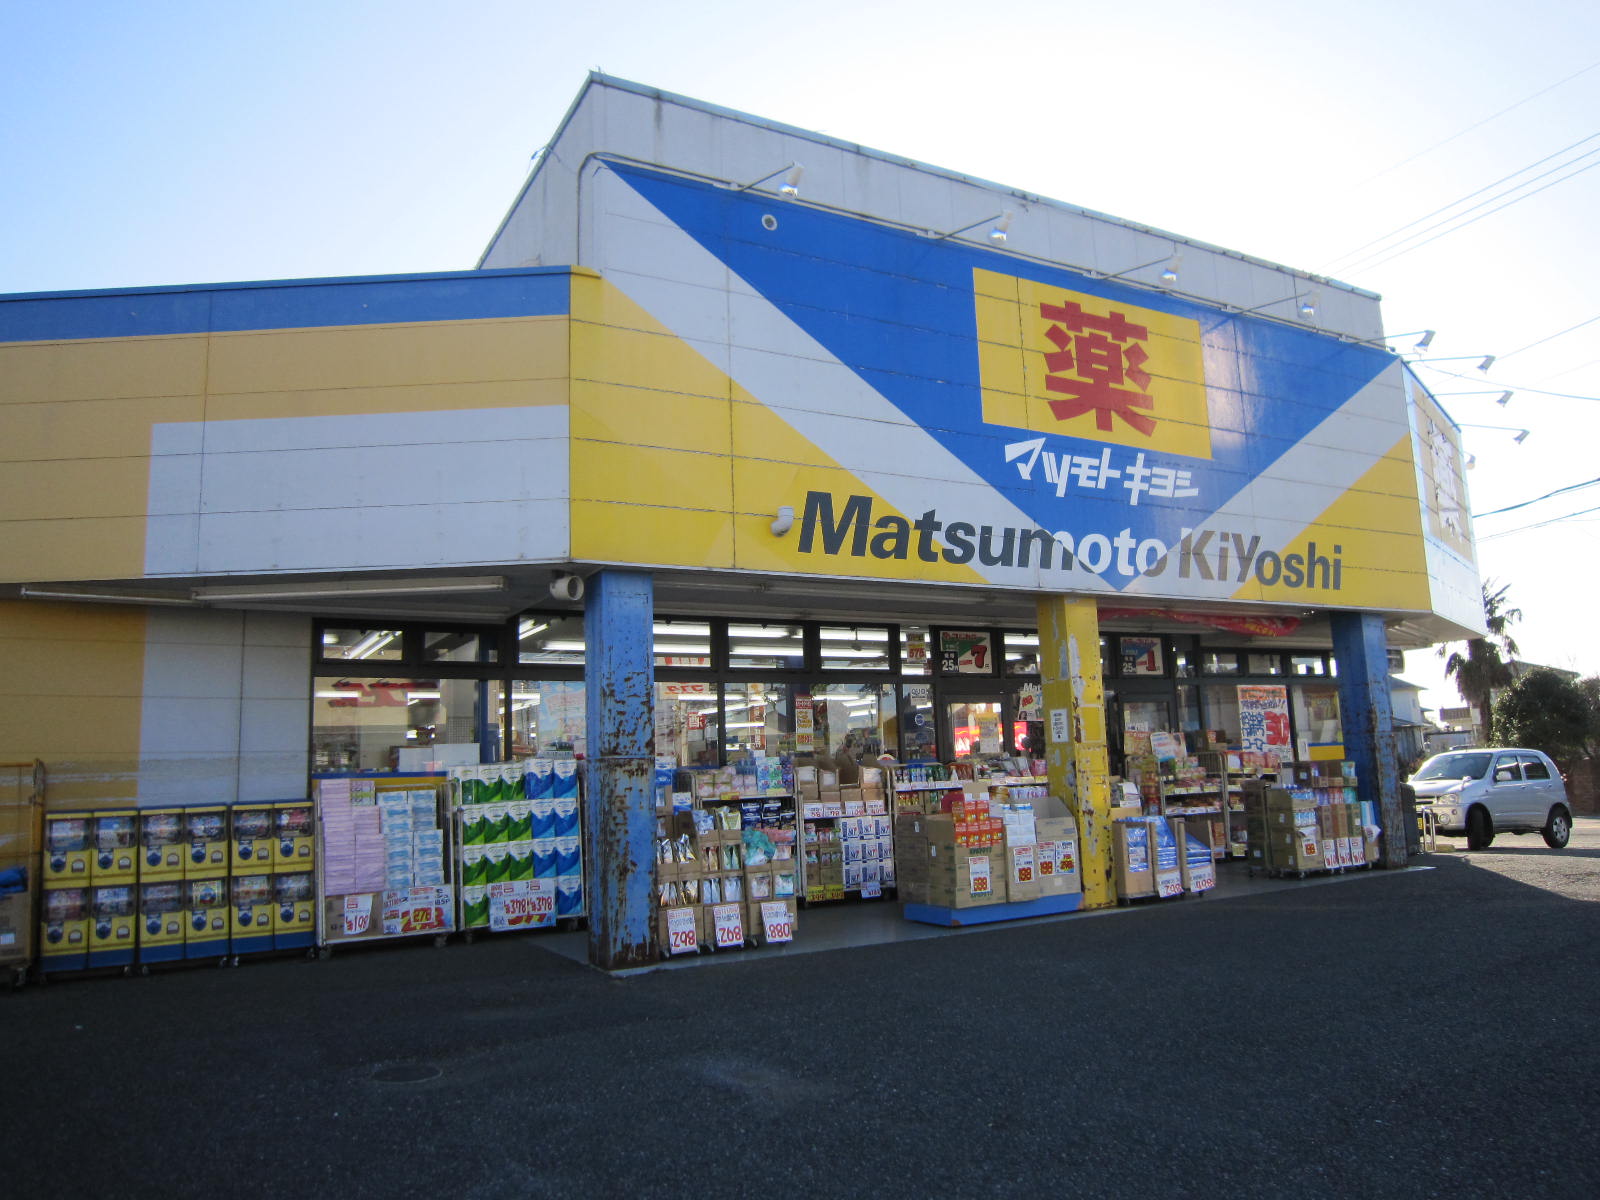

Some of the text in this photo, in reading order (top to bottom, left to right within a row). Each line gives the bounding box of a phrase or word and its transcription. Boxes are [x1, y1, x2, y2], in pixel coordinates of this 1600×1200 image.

[1040, 300, 1158, 437] 薬
[1004, 437, 1199, 506] マツモトキヨシ
[797, 490, 1168, 577] Matsumoto
